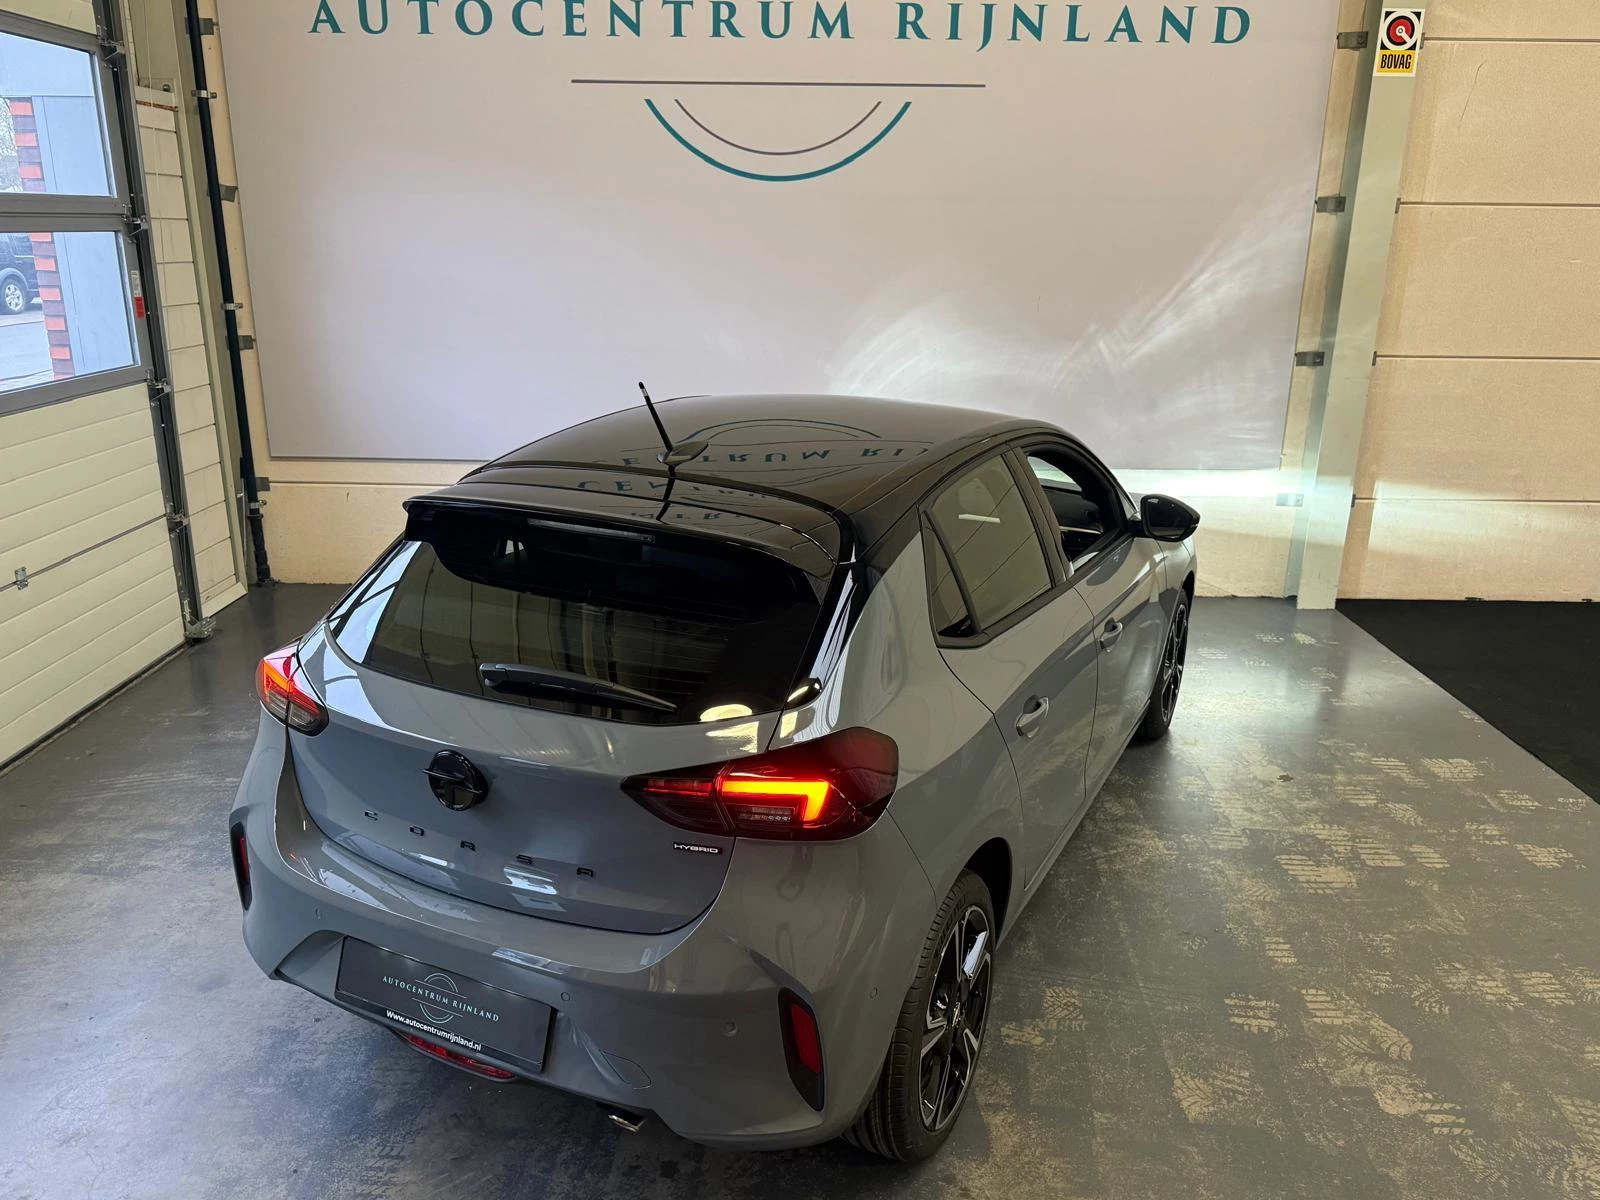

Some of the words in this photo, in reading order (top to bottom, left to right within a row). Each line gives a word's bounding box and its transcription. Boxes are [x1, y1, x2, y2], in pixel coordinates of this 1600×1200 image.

[307, 0, 855, 40] AUTOCENTRUM
[894, 1, 1251, 52] RIJNLAND
[1380, 53, 1412, 70] BOVAG
[673, 843, 719, 854] HYBRID
[382, 975, 449, 1005] AUTOCENTRUM
[452, 999, 500, 1022] RIJNLAND
